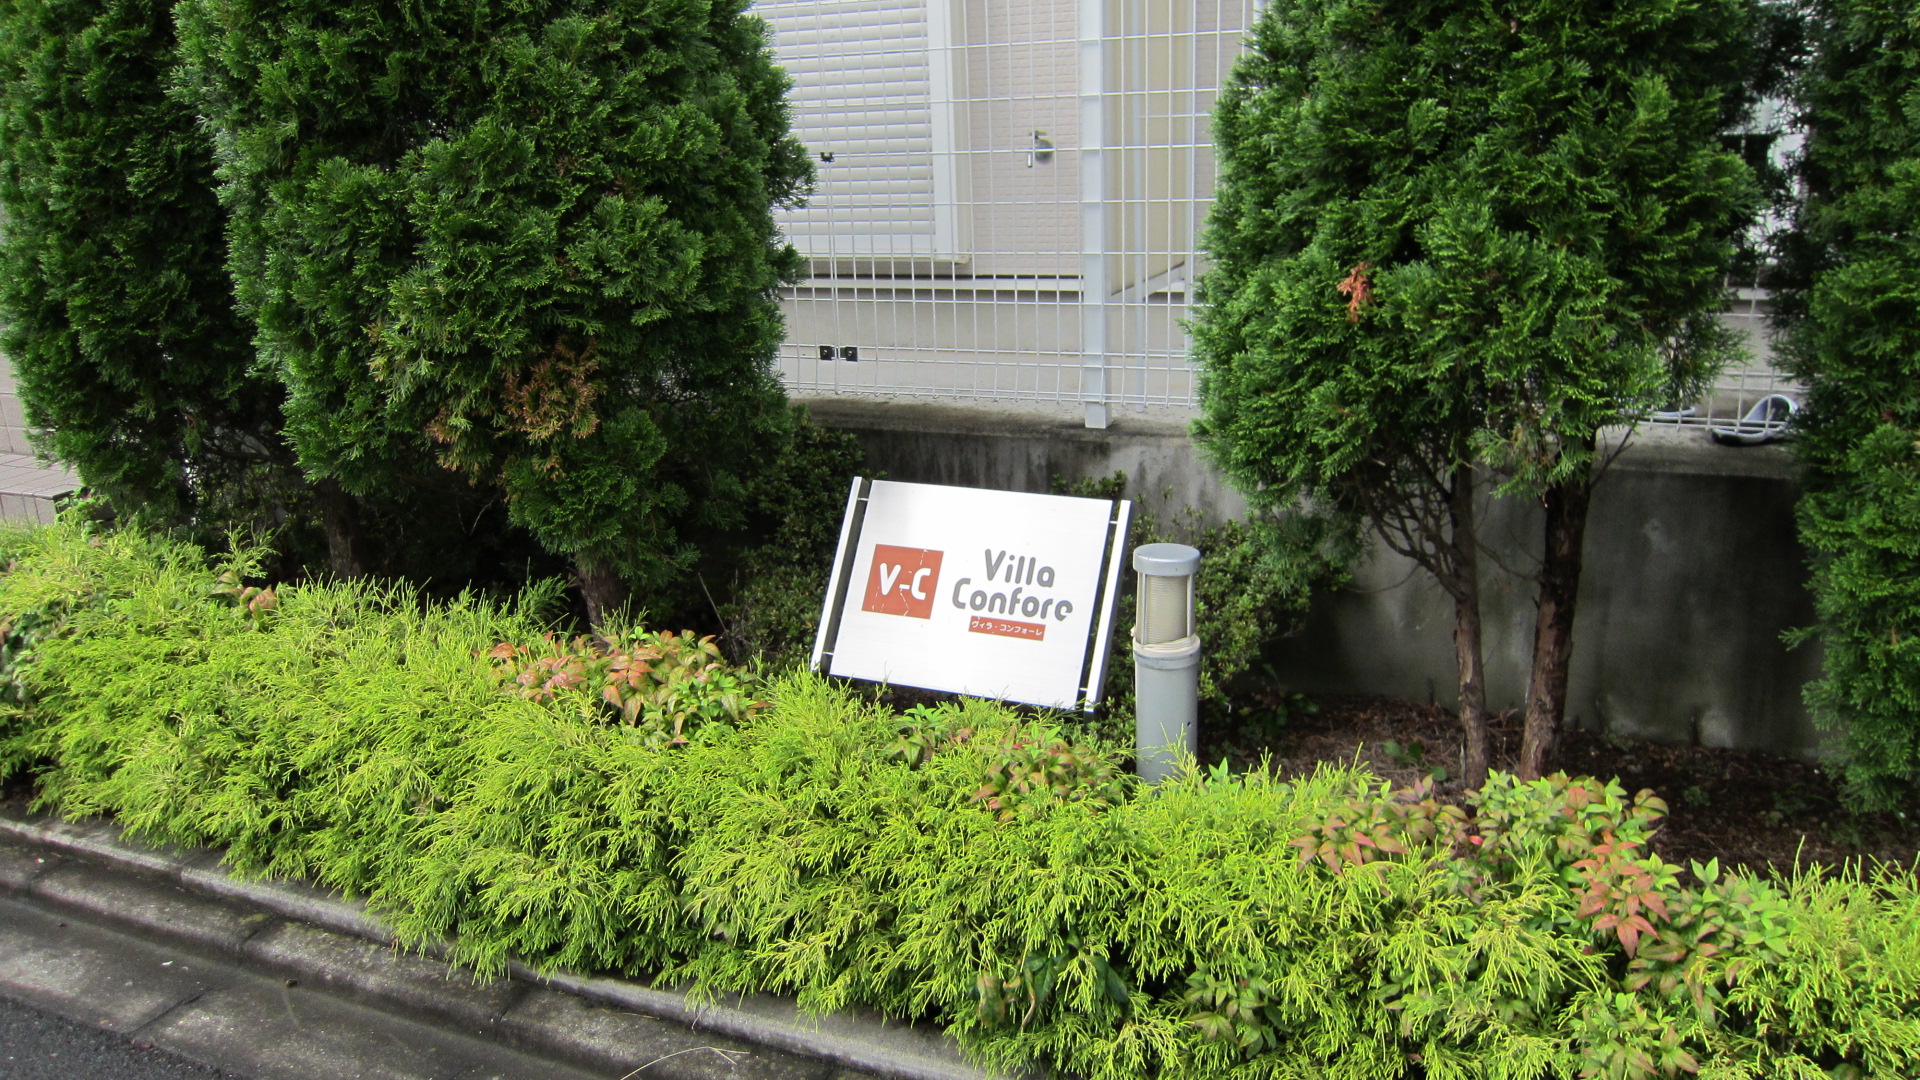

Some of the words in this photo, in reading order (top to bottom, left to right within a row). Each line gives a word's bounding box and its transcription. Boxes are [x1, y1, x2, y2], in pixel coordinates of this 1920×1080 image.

[879, 562, 931, 601] V-C
[984, 548, 1055, 588] Villa
[952, 577, 1073, 622] Confore
